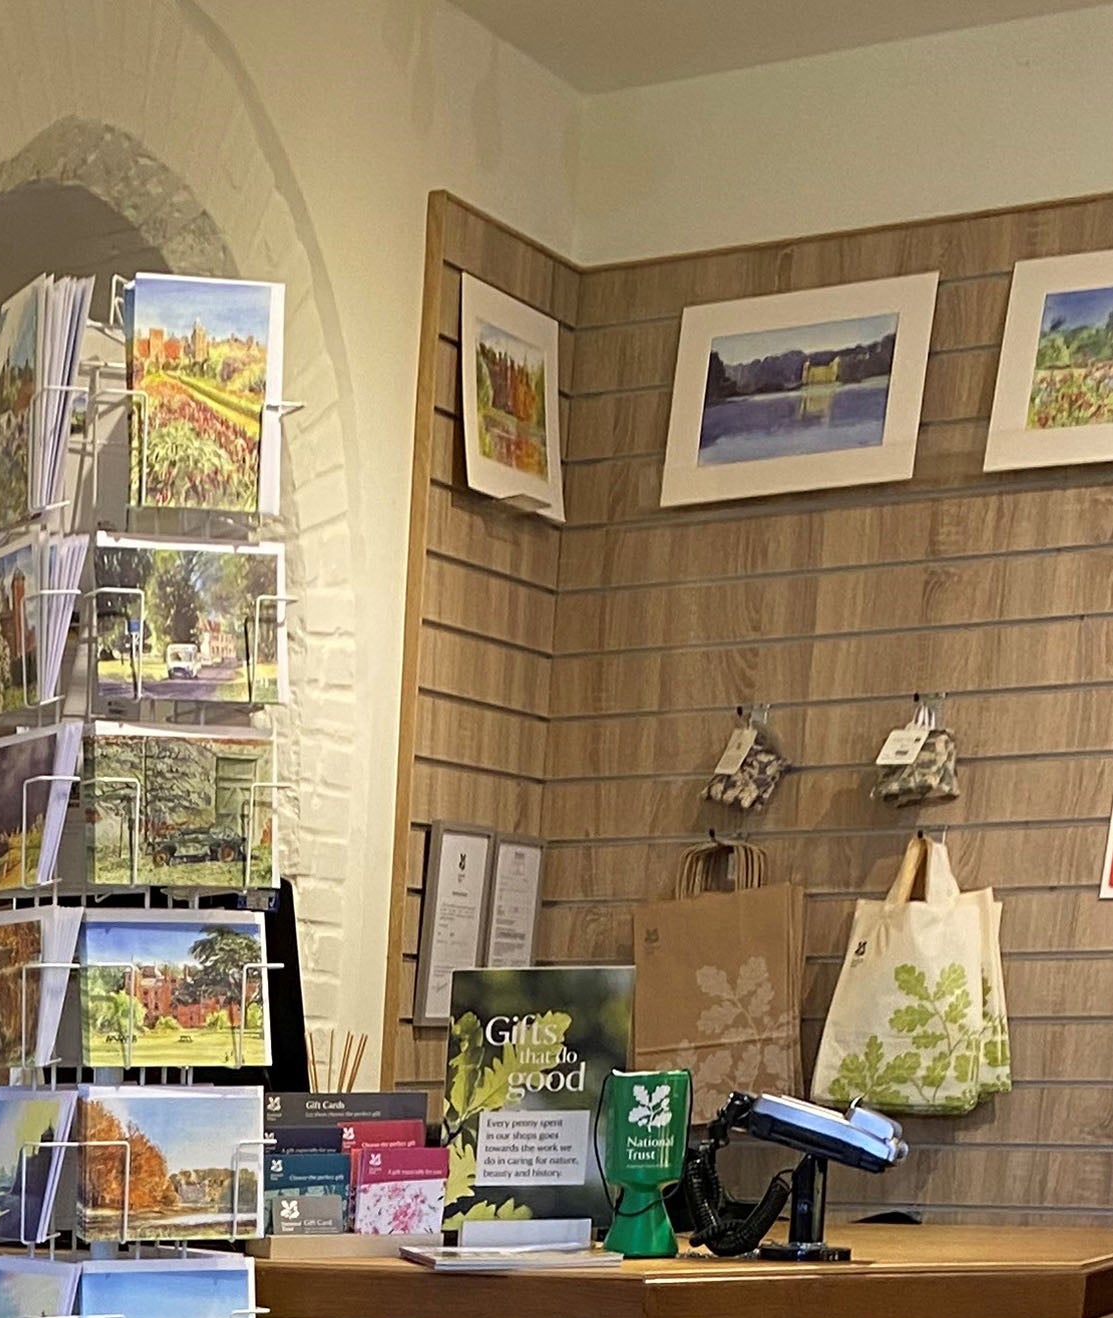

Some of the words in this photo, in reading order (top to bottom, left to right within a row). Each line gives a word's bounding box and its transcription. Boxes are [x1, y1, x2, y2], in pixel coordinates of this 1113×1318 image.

[485, 1014, 558, 1046] Gifts
[519, 1048, 551, 1065] that
[555, 1046, 578, 1064] do
[505, 1061, 587, 1102] good
[305, 1101, 321, 1110] Gift
[322, 1101, 345, 1110] Cards
[486, 1118, 509, 1130] Every
[511, 1119, 538, 1129] penny
[540, 1119, 564, 1129] spent
[486, 1131, 495, 1140] in
[512, 1131, 536, 1141] shops
[538, 1132, 559, 1141] goes
[626, 1135, 674, 1148] National
[484, 1144, 519, 1153] towards
[521, 1143, 534, 1152] the
[536, 1143, 560, 1152] work
[483, 1157, 496, 1165] do
[497, 1157, 505, 1165] in
[506, 1156, 533, 1167] caring
[535, 1155, 548, 1164] for
[627, 1149, 656, 1161] Trust
[483, 1169, 512, 1179] beauty
[514, 1169, 531, 1177] and
